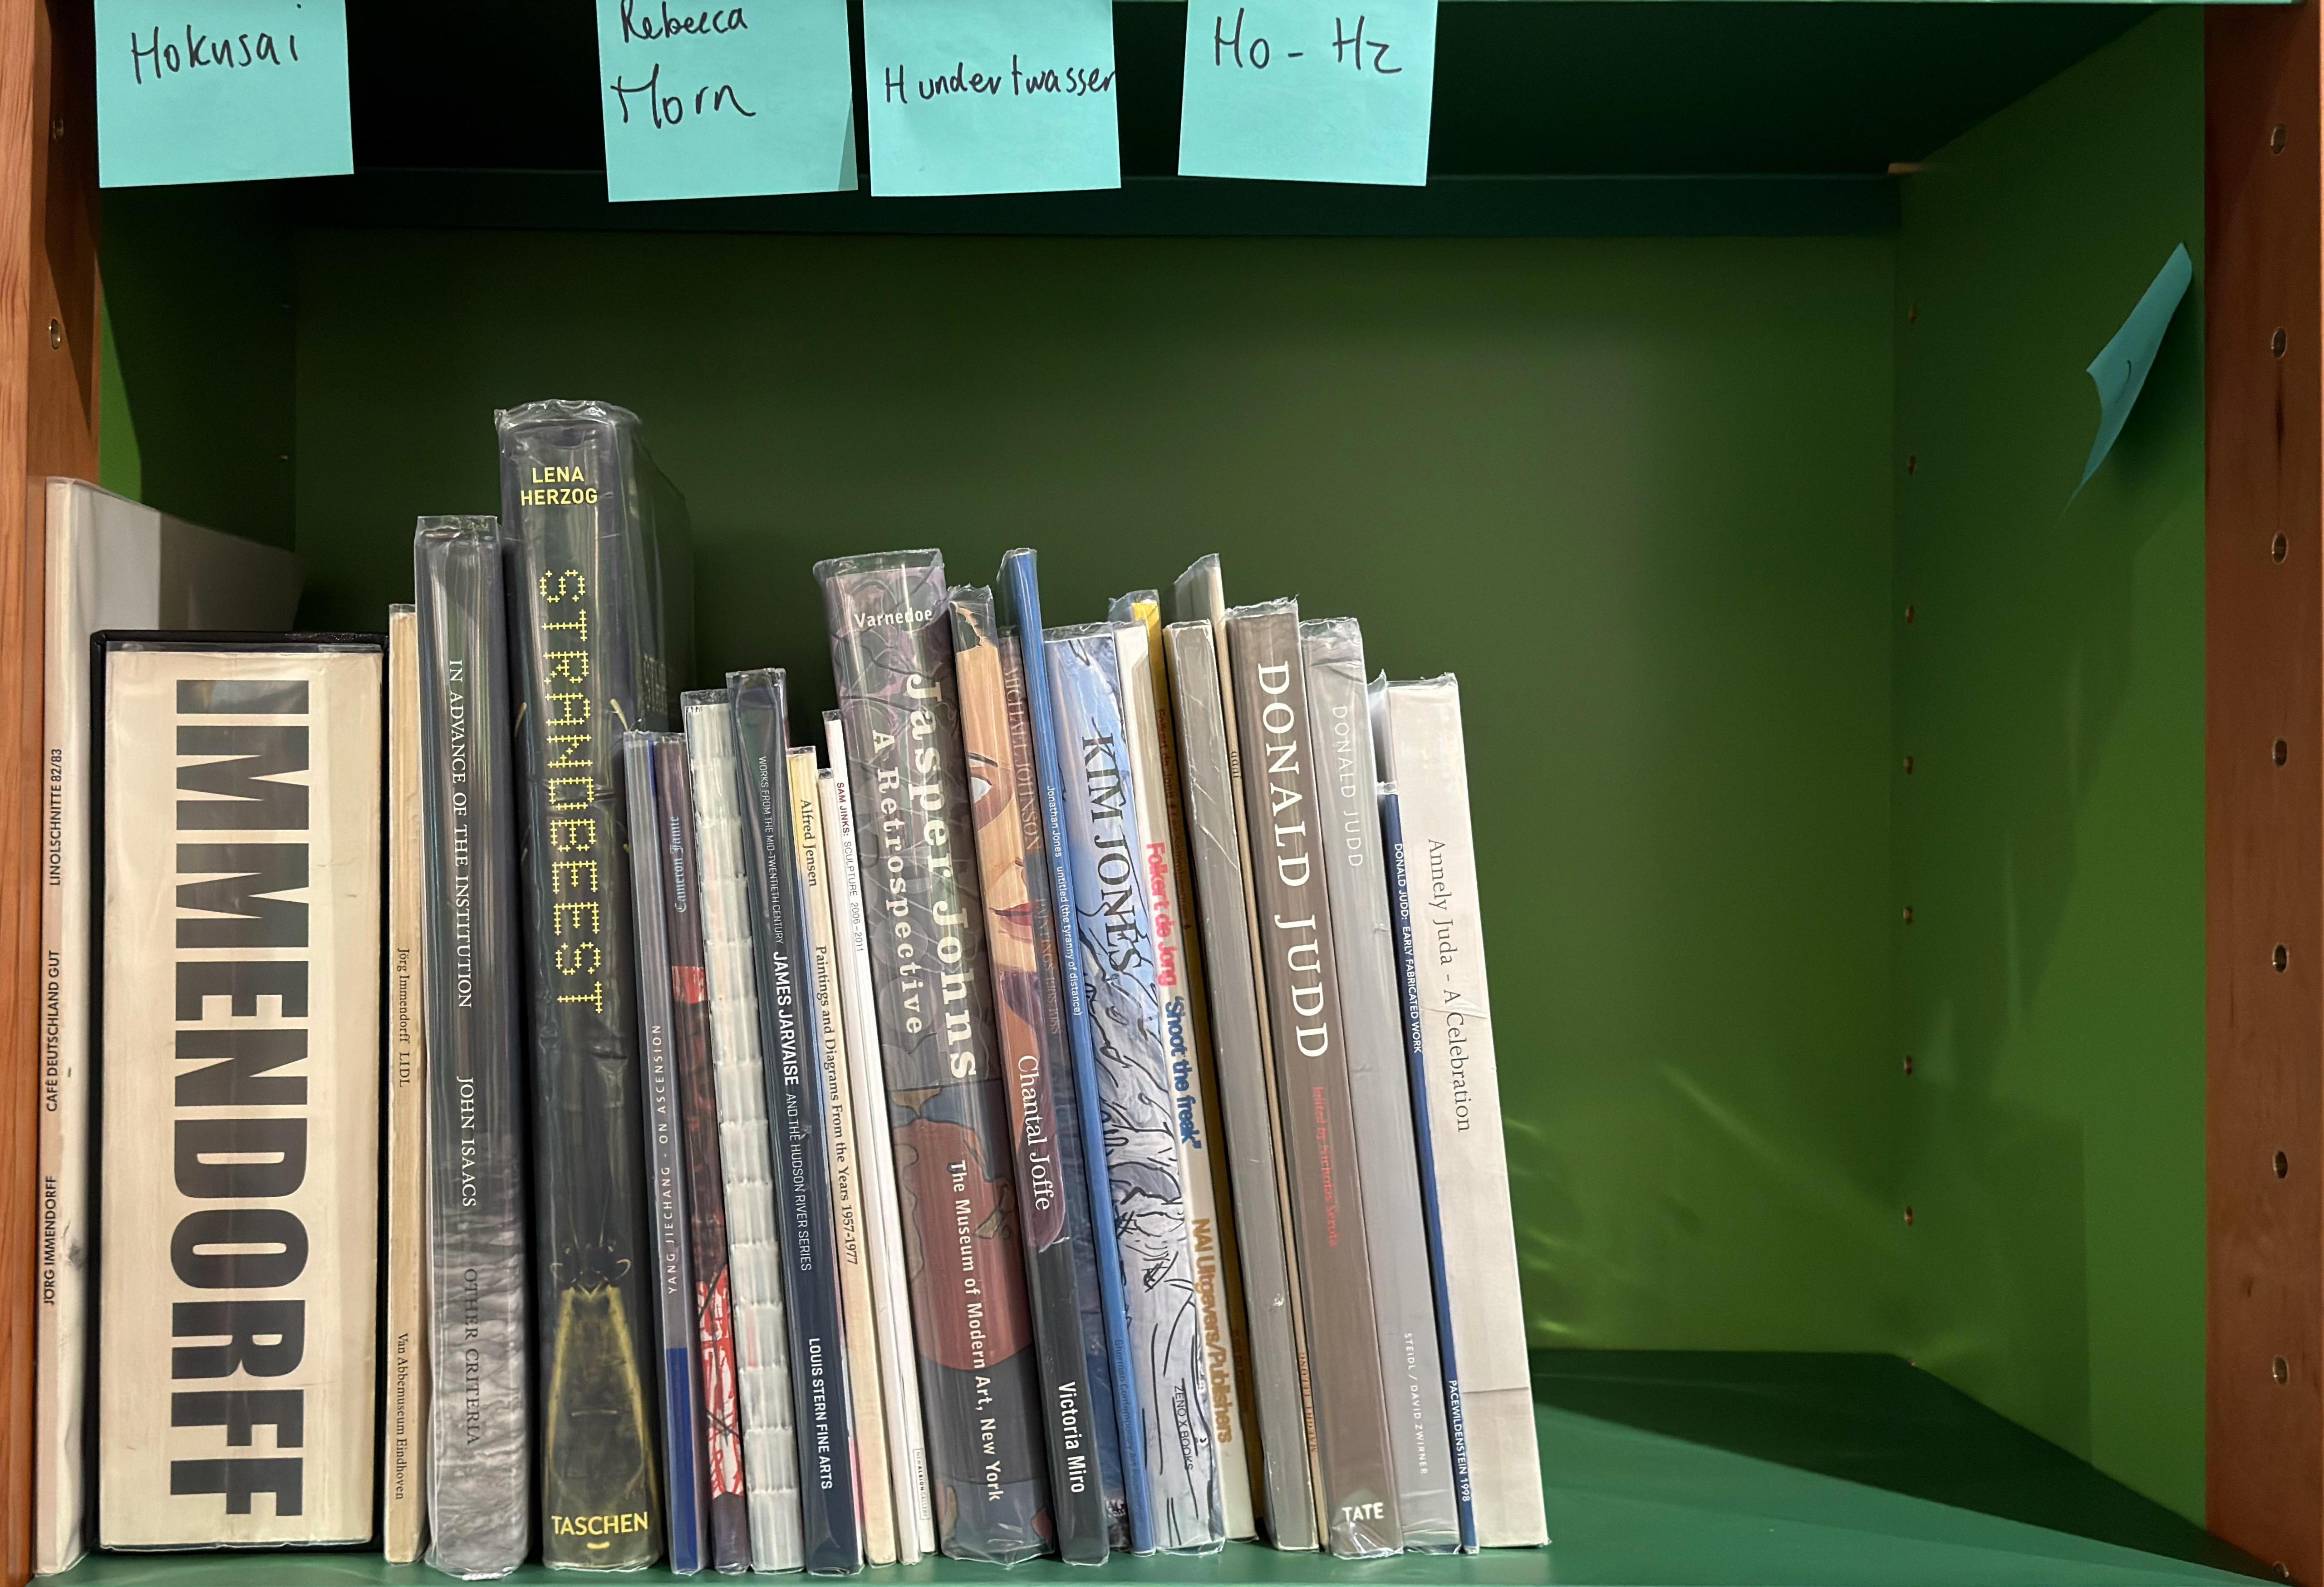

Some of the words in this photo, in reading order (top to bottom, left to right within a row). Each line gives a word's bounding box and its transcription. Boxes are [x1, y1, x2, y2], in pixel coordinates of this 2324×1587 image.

[620, 0, 748, 43] Rebecca
[1214, 7, 1270, 69] Ho
[1332, 15, 1403, 74] Hz
[130, 3, 302, 85] Hokusai
[611, 63, 757, 129] Horn
[885, 54, 1116, 105] Hundertwasser
[531, 466, 585, 483] LENA
[521, 487, 598, 506] HERZOG
[854, 607, 933, 628] Varnedoe
[449, 659, 463, 682] IN
[450, 690, 466, 783] ADVANCE
[871, 729, 895, 754] A
[51, 748, 62, 782] 82/83
[758, 756, 771, 788] WORKS
[1081, 733, 1124, 823] KIM
[1258, 661, 1311, 887] DONALD
[1332, 706, 1356, 798] DONALD
[1344, 810, 1363, 866] JUDD
[453, 792, 467, 816] OF
[540, 570, 603, 1013] STRANDBEEST
[761, 790, 772, 815] FROM
[836, 782, 846, 803] SAM
[1016, 762, 1041, 851] JOHNSON
[1046, 785, 1060, 828] Jonathan
[49, 785, 61, 885] LINOLSCHNITTE
[764, 816, 773, 833] THE
[800, 799, 814, 840] Alfred
[839, 805, 850, 837] JINKS:
[454, 824, 469, 867] THE
[802, 843, 818, 886] Jensen
[1052, 830, 1063, 858] Jones
[1394, 843, 1406, 887] DONALD
[673, 858, 687, 913] Cameron
[765, 835, 781, 903] MID-TWENTIETH
[844, 840, 858, 897] SCULPTURE
[906, 673, 953, 879] Jasper
[931, 900, 977, 1081] Johns
[1056, 866, 1068, 902] untitled
[1146, 842, 1171, 912] Folkert
[1428, 839, 1448, 910] Annely
[875, 766, 926, 1034] Retrospective
[1059, 904, 1071, 923] (the
[1094, 835, 1142, 973] JONES
[1398, 889, 1409, 921] JUDD:
[455, 875, 472, 1009] INSTITUTION
[771, 904, 784, 944] CENTURY
[1062, 924, 1074, 959] tyranny
[1157, 913, 1176, 938] de
[1402, 926, 1413, 956] EARLY
[1433, 919, 1458, 966] Juda
[48, 950, 60, 978] GUT
[397, 948, 410, 972] Jörg
[773, 951, 792, 1006] JAMES
[815, 945, 831, 1006] Paintings
[1068, 961, 1077, 971] of
[1157, 941, 1178, 987] Jong
[1070, 973, 1081, 1016] distance)
[1273, 914, 1329, 1058] JUDD
[1405, 959, 1419, 1019] FABRICATED
[1444, 989, 1461, 1004] A
[46, 981, 60, 1076] DEUTSCHLAND
[398, 975, 410, 1043] Immendorff
[821, 1010, 835, 1034] and
[778, 1009, 799, 1086] JARVAISE
[1411, 1021, 1422, 1053] WORK
[399, 1051, 410, 1087] LIDL
[652, 1026, 667, 1114] ASCENSION
[823, 1038, 840, 1101] Diagrams
[1173, 1060, 1192, 1091] the
[1445, 1011, 1471, 1132] Celebration
[169, 678, 310, 1517] IMMENDORFF
[457, 1076, 475, 1130] JOHN
[786, 1093, 798, 1117] AND
[1017, 1055, 1047, 1146] Chantal
[1313, 1087, 1328, 1124] Edited
[658, 1124, 668, 1144] ON
[788, 1119, 800, 1141] THE
[831, 1105, 844, 1138] From
[1317, 1127, 1329, 1142] by
[461, 1138, 477, 1207] ISAACS
[790, 1144, 805, 1192] HUDSON
[836, 1142, 847, 1163] the
[1320, 1145, 1334, 1202] Nicholas
[838, 1166, 851, 1201] Years
[950, 1160, 968, 1192] The
[1029, 1151, 1054, 1211] Joffe
[44, 1176, 57, 1266] IMMENDORFF
[661, 1167, 674, 1244] JIECHANG
[796, 1194, 808, 1228] RIVER
[1326, 1205, 1340, 1246] Serota
[798, 1230, 812, 1271] SERIES
[841, 1204, 858, 1265] 1957-1977
[954, 1199, 975, 1272] Museum
[667, 1254, 678, 1294] YANG
[964, 1277, 980, 1294] of
[464, 1268, 479, 1339] OTHER
[397, 1332, 408, 1354] Van
[809, 1338, 824, 1376] LOUIS
[967, 1302, 990, 1369] Modern
[1404, 1332, 1416, 1370] STEIDL
[396, 1356, 408, 1435] Abbemuseum
[465, 1347, 482, 1446] CRITERIA
[813, 1378, 828, 1421] STERN
[974, 1375, 993, 1410] Art,
[1174, 1386, 1187, 1417] ZENO
[1410, 1385, 1421, 1419] DAVID
[980, 1418, 999, 1454] New
[1056, 1381, 1081, 1450] Victoria
[1179, 1420, 1188, 1429] X
[816, 1424, 830, 1453] FINE
[1181, 1430, 1194, 1471] BOOKS
[1415, 1424, 1428, 1474] ZWIRNER
[1449, 1380, 1468, 1474] PACEWILDENSTEIN
[1460, 1478, 1470, 1502] 1998
[395, 1438, 408, 1500] Eindhoven
[819, 1455, 833, 1489] ARTS
[985, 1459, 1004, 1502] York
[1067, 1455, 1087, 1494] Miro
[551, 1511, 649, 1535] TASCHEN
[1341, 1502, 1384, 1522] TATE
